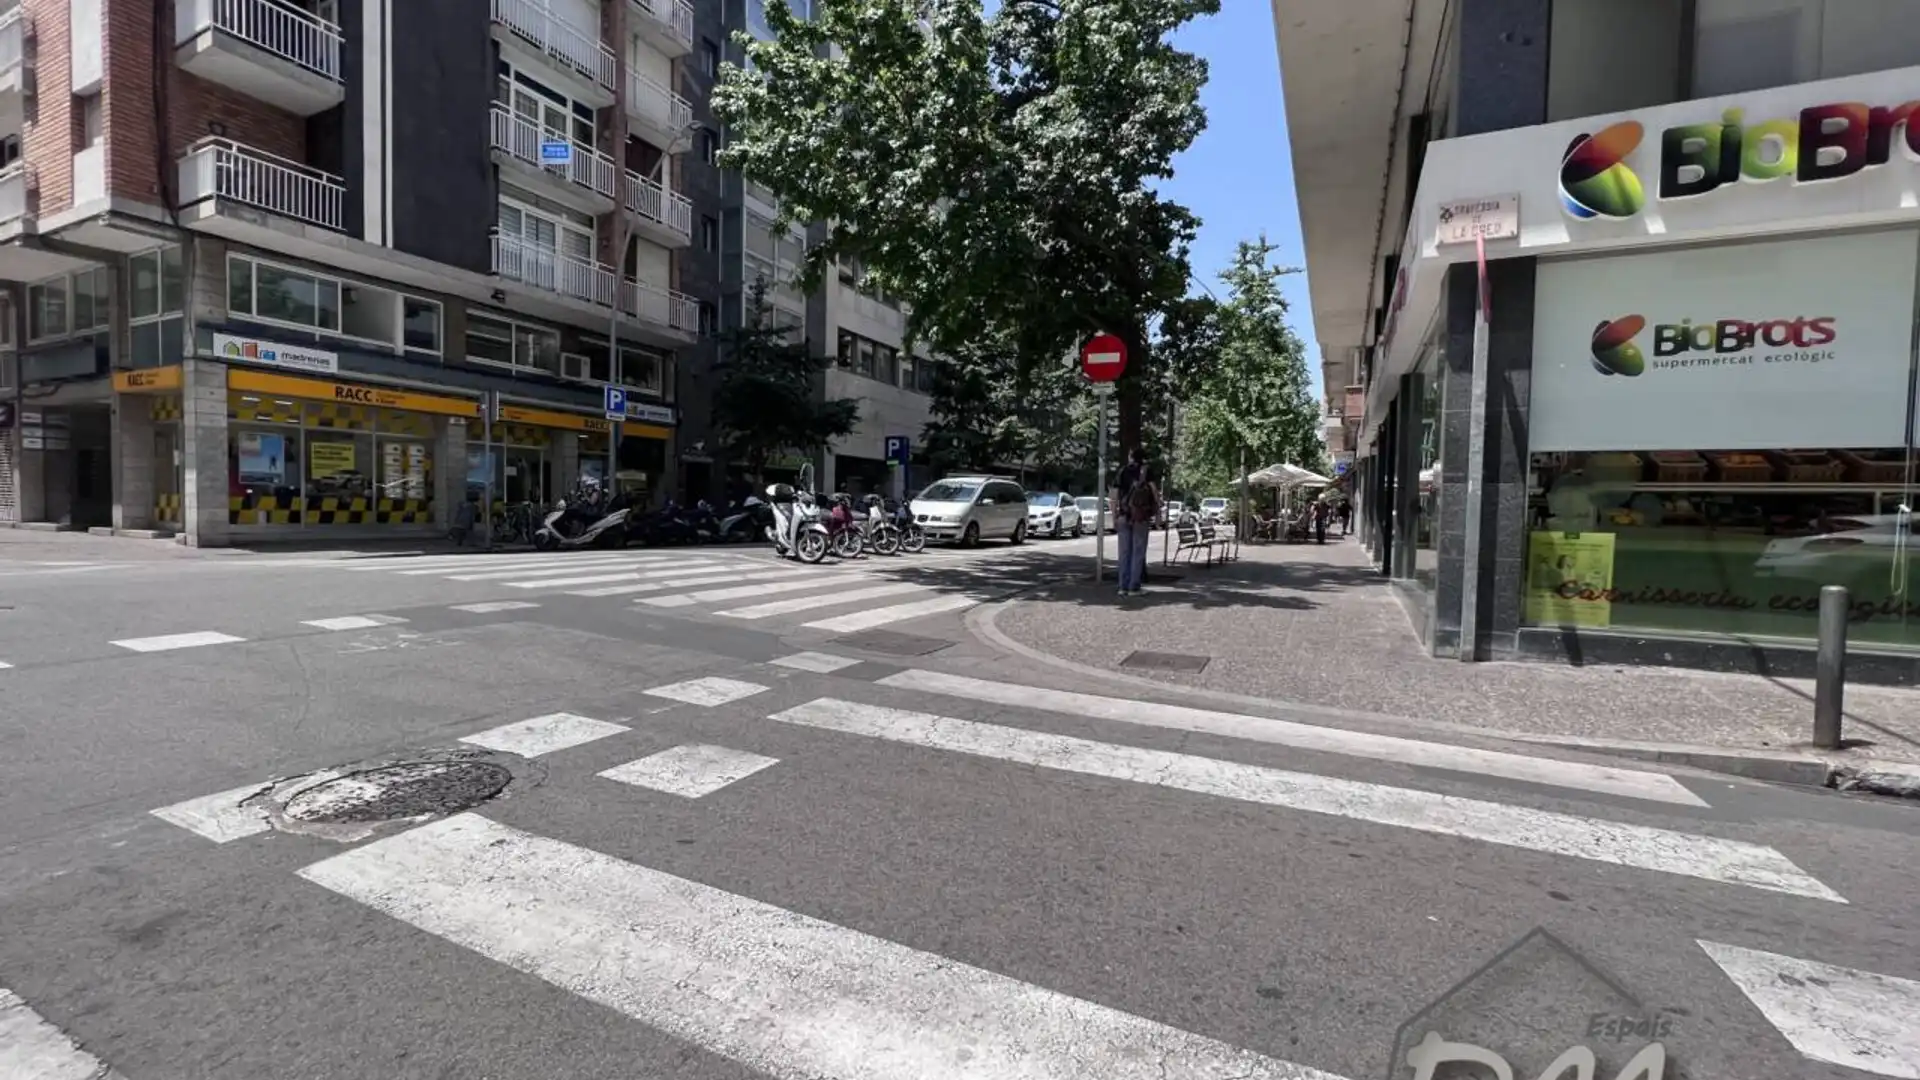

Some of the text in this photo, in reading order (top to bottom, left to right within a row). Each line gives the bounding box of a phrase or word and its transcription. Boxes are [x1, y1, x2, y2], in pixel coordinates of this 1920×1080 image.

[1653, 316, 1837, 356] BioBrots
[1652, 349, 1836, 369] supermercat ecològic
[335, 386, 373, 403] RACC
[610, 390, 622, 408] P
[888, 439, 900, 457] P
